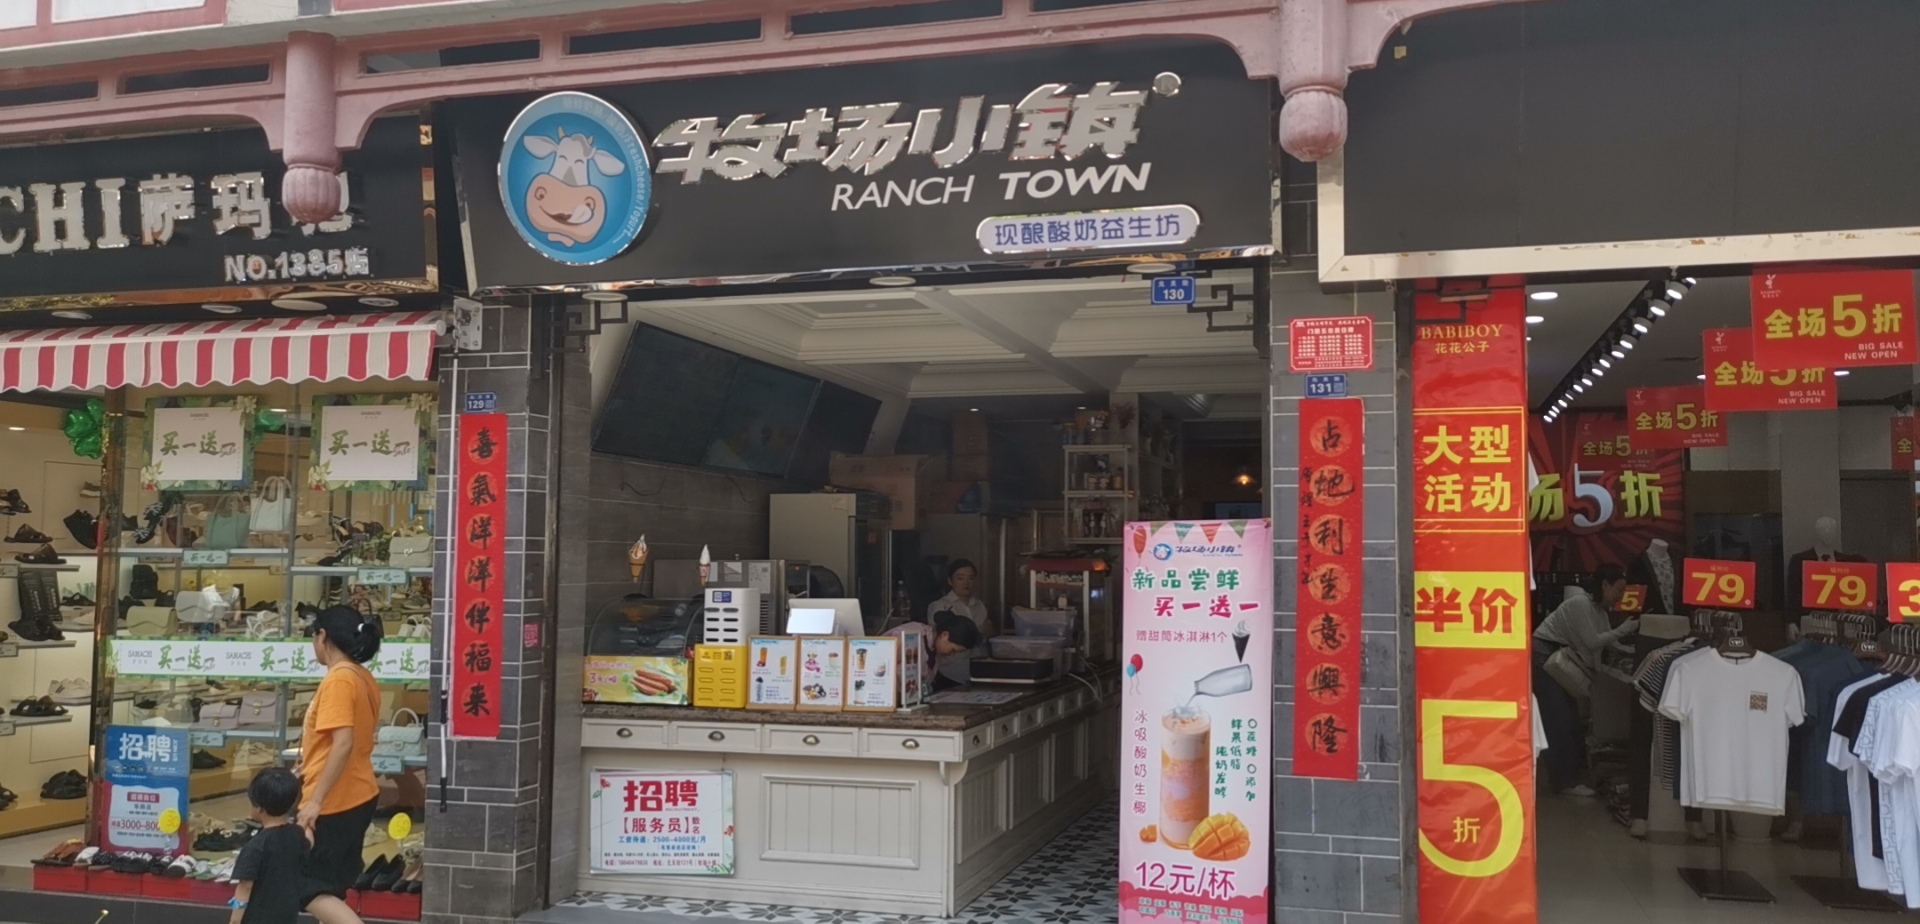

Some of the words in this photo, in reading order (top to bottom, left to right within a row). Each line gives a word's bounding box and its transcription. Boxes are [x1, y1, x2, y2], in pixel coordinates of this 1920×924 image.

[652, 81, 1149, 184] 牧场小镇
[831, 175, 975, 211] RANCH
[999, 162, 1152, 201] TOWN
[994, 213, 1181, 246] 现酿酸奶益生坊
[1163, 289, 1185, 300] 130
[1764, 294, 1903, 339] 全场5折
[1421, 324, 1503, 339] BABIBOY
[1879, 341, 1904, 350] SALE
[1435, 341, 1489, 354] 花花公子
[1844, 352, 1867, 360] NEW
[1871, 350, 1898, 359] OPEN
[1310, 383, 1332, 393] 131
[468, 400, 484, 409] 129
[1635, 403, 1719, 431] 全场5折
[1422, 425, 1511, 465] 大型
[1423, 472, 1511, 513] 活动
[1132, 568, 1240, 591] 新品尝鲜
[1154, 595, 1259, 618] 买一送一
[1414, 586, 1518, 634] 半价
[1136, 630, 1228, 643] 赠甜筒冰淇淋1个
[119, 732, 171, 762] 招聘
[623, 780, 699, 813] 招聘
[1418, 699, 1524, 878] 5
[1453, 817, 1480, 843] 折
[1136, 861, 1235, 899] 12元/杯
